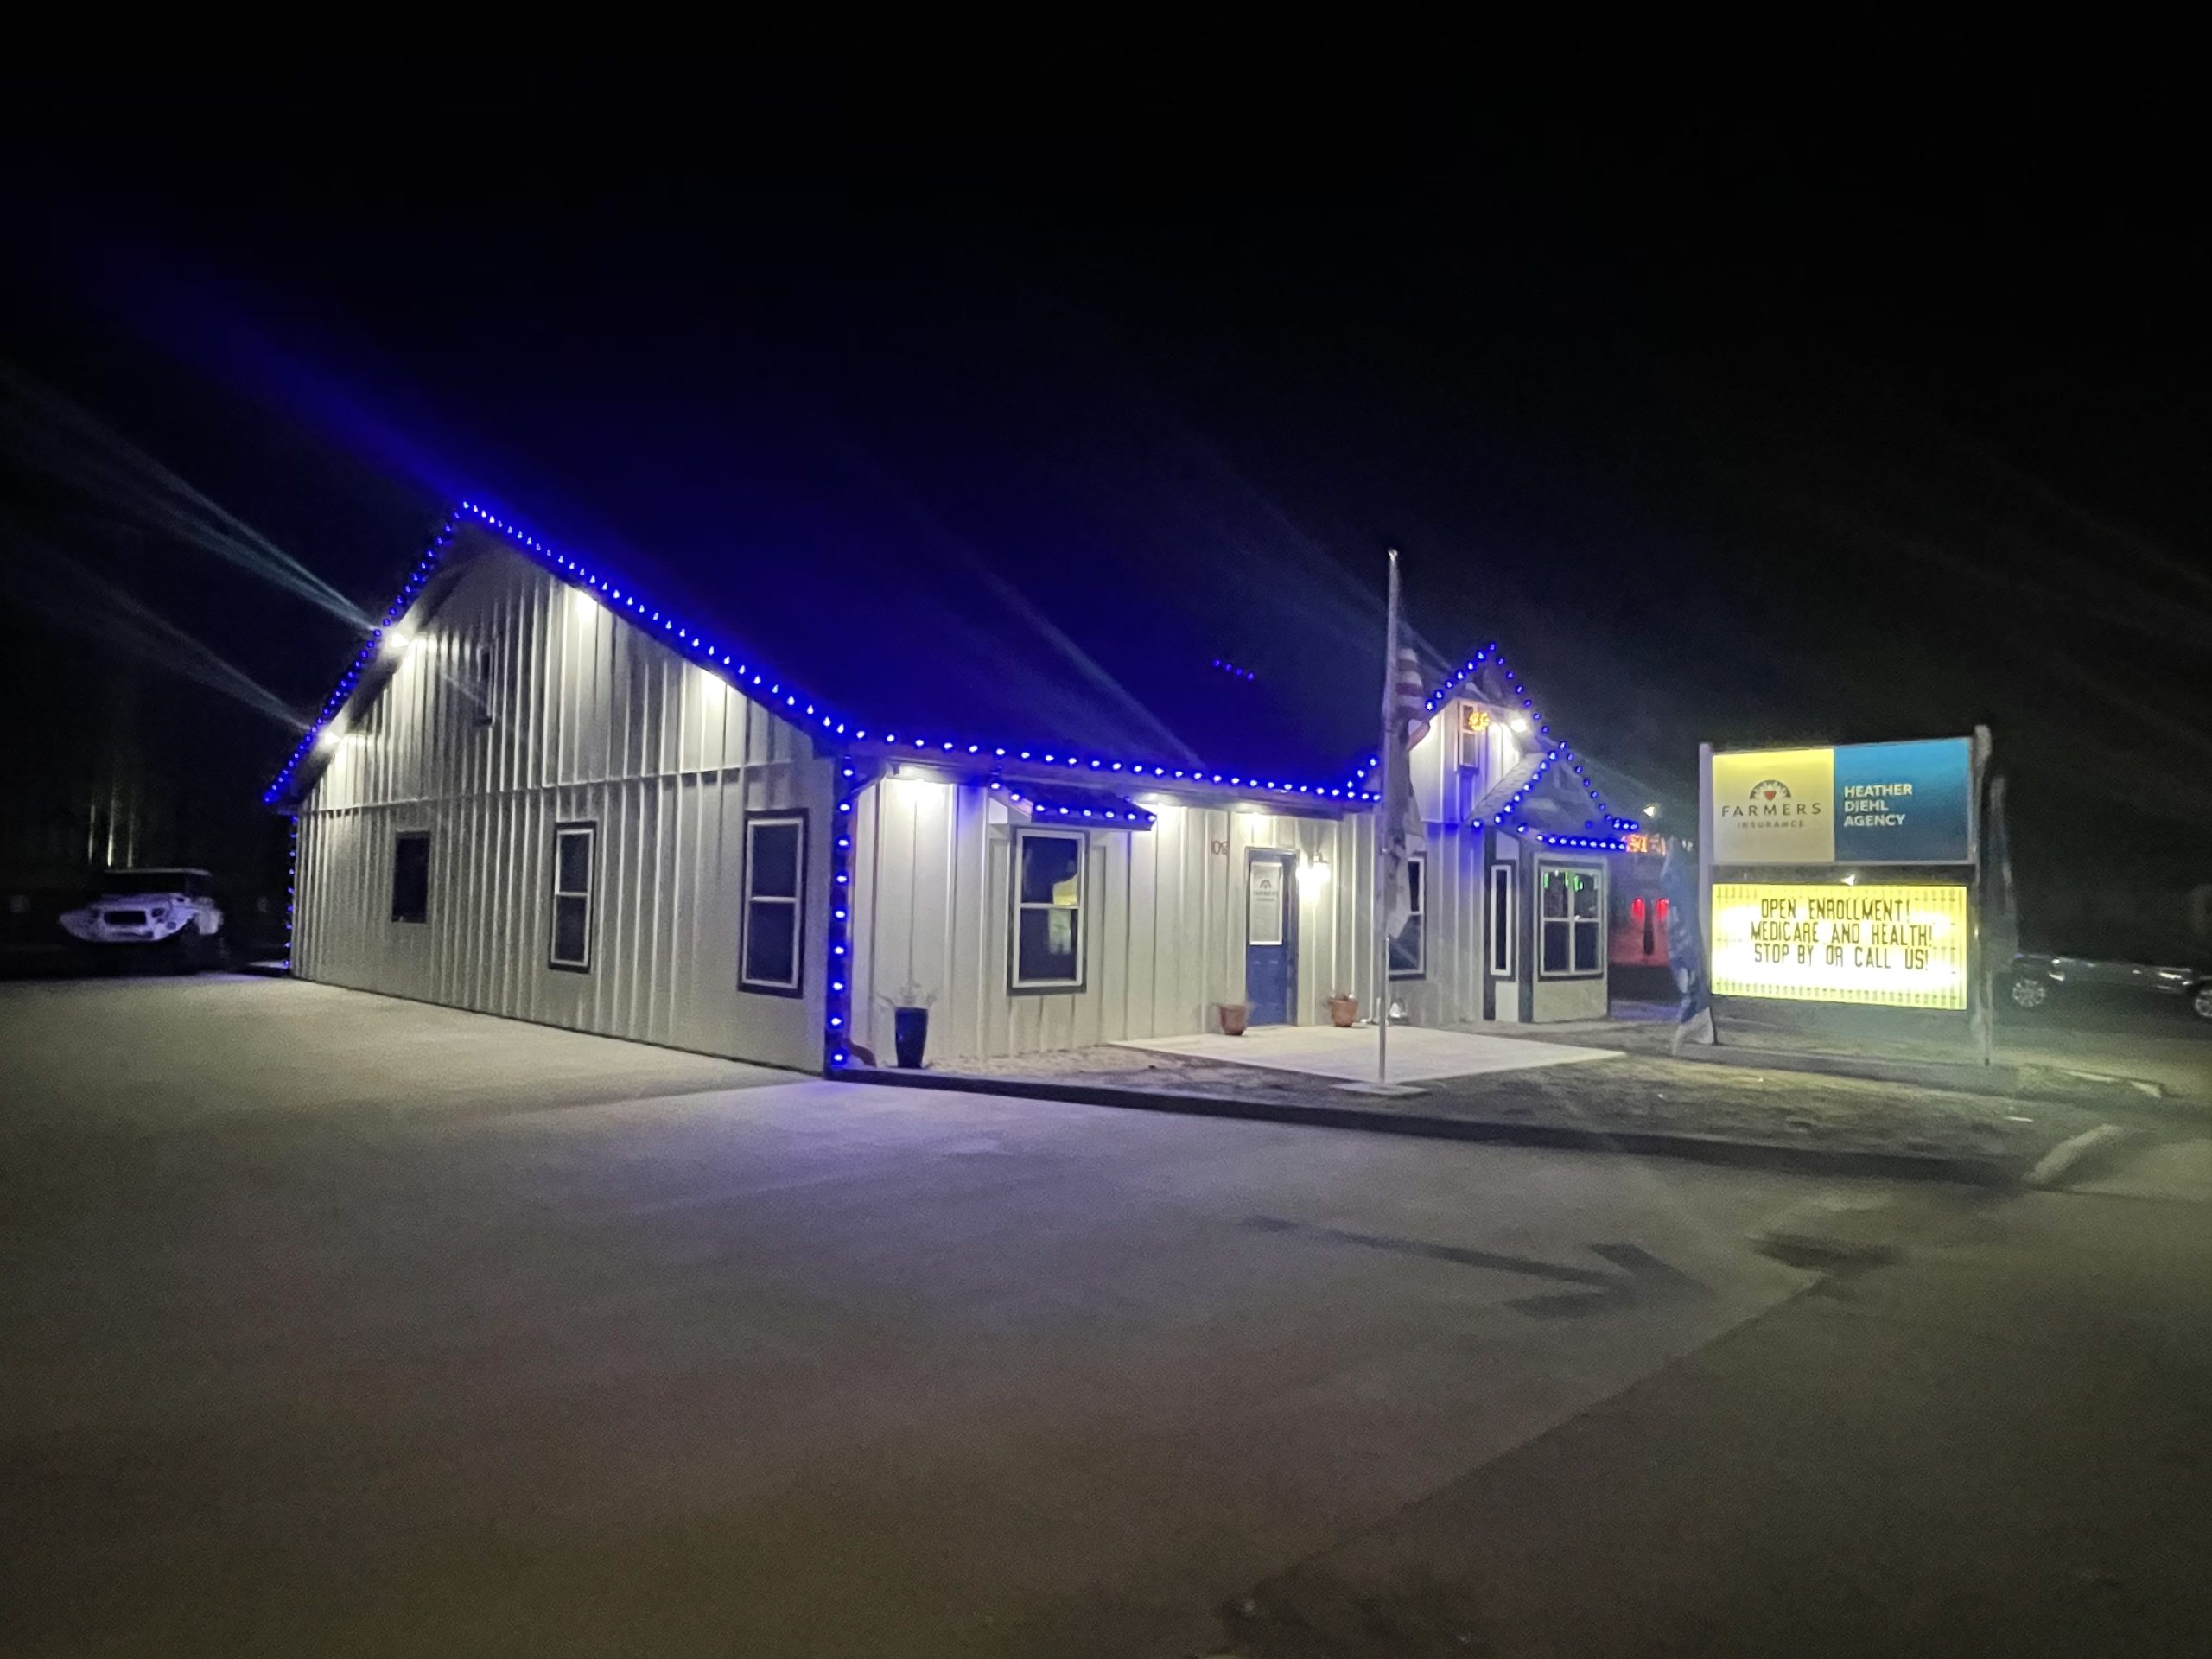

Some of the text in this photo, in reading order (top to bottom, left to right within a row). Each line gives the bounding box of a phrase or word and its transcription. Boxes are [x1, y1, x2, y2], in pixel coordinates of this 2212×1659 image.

[1844, 783, 1913, 798] HEATHER
[1721, 802, 1821, 817] FARMERS
[1844, 799, 1890, 813] DIEHL
[1737, 820, 1805, 829] INSURANCE
[1843, 813, 1906, 827] AGENCY
[1761, 898, 1910, 923] OPEN ENROLLMENT!
[1751, 920, 1932, 947] MEDICARE AND HEALTH!
[1754, 943, 1928, 971] STOP BY OR CALL US!
